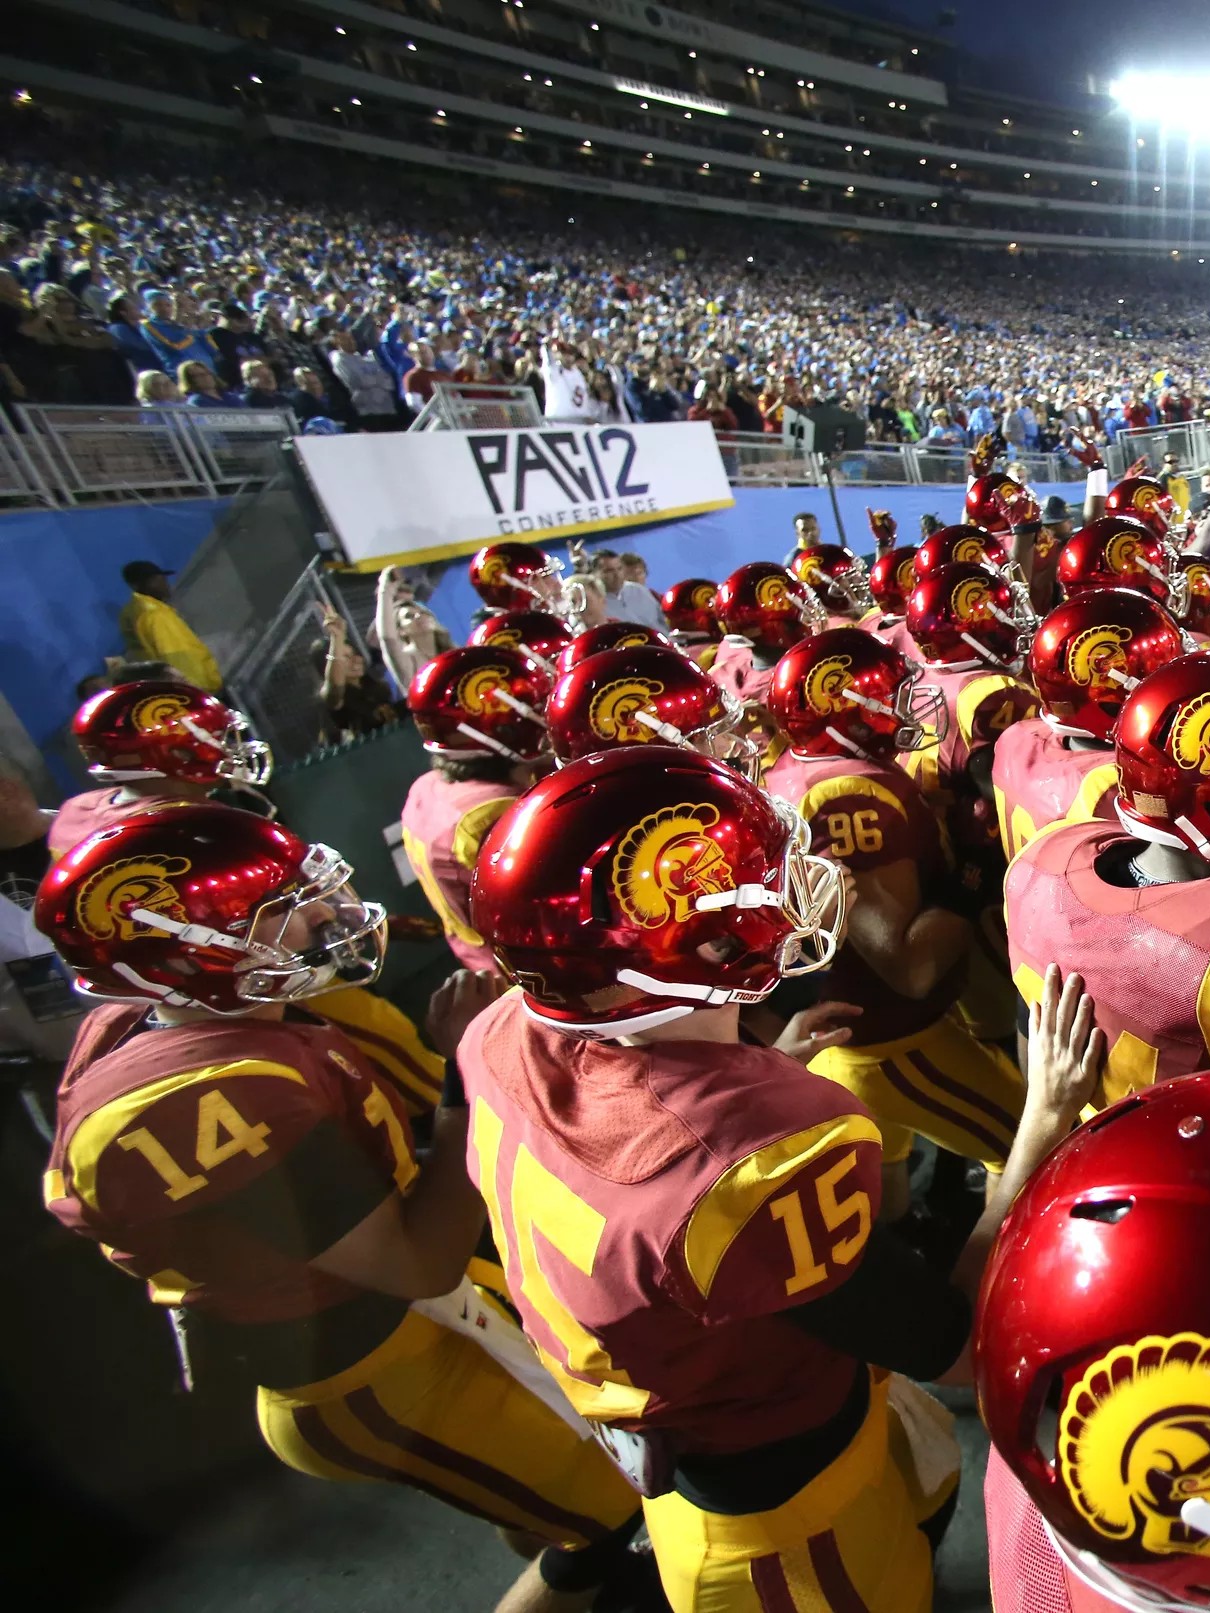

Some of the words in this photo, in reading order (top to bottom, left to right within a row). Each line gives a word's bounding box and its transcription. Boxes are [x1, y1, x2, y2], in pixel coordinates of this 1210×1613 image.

[497, 498, 660, 536] CONFERENCE
[827, 809, 884, 857] 96
[734, 991, 761, 1001] FIGHT
[117, 1089, 272, 1201] 14
[770, 1150, 871, 1296] 15
